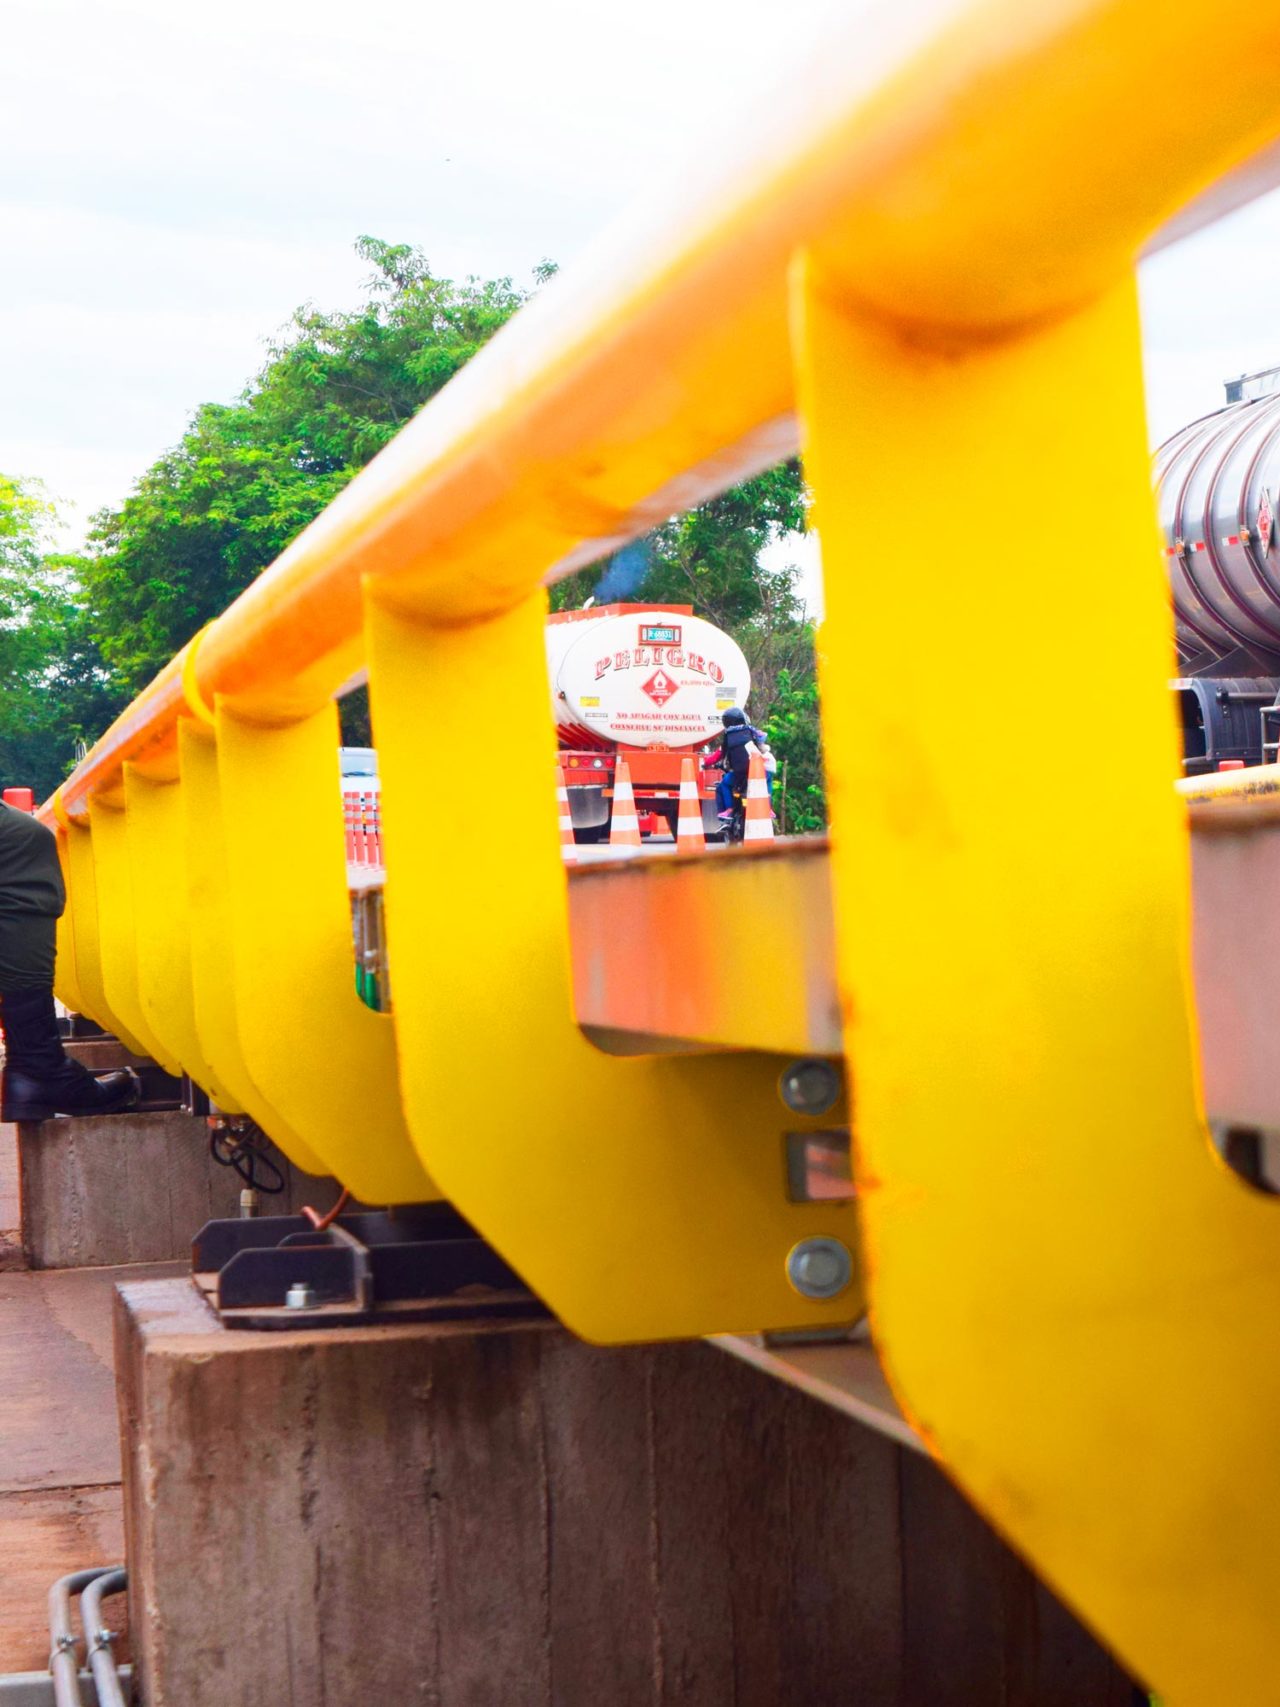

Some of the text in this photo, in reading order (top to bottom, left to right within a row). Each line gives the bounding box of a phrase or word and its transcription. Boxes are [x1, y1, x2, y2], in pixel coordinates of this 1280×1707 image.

[594, 647, 725, 684] PELIGRO
[616, 712, 628, 720] NO
[664, 712, 681, 720] CON
[653, 724, 665, 732] SU
